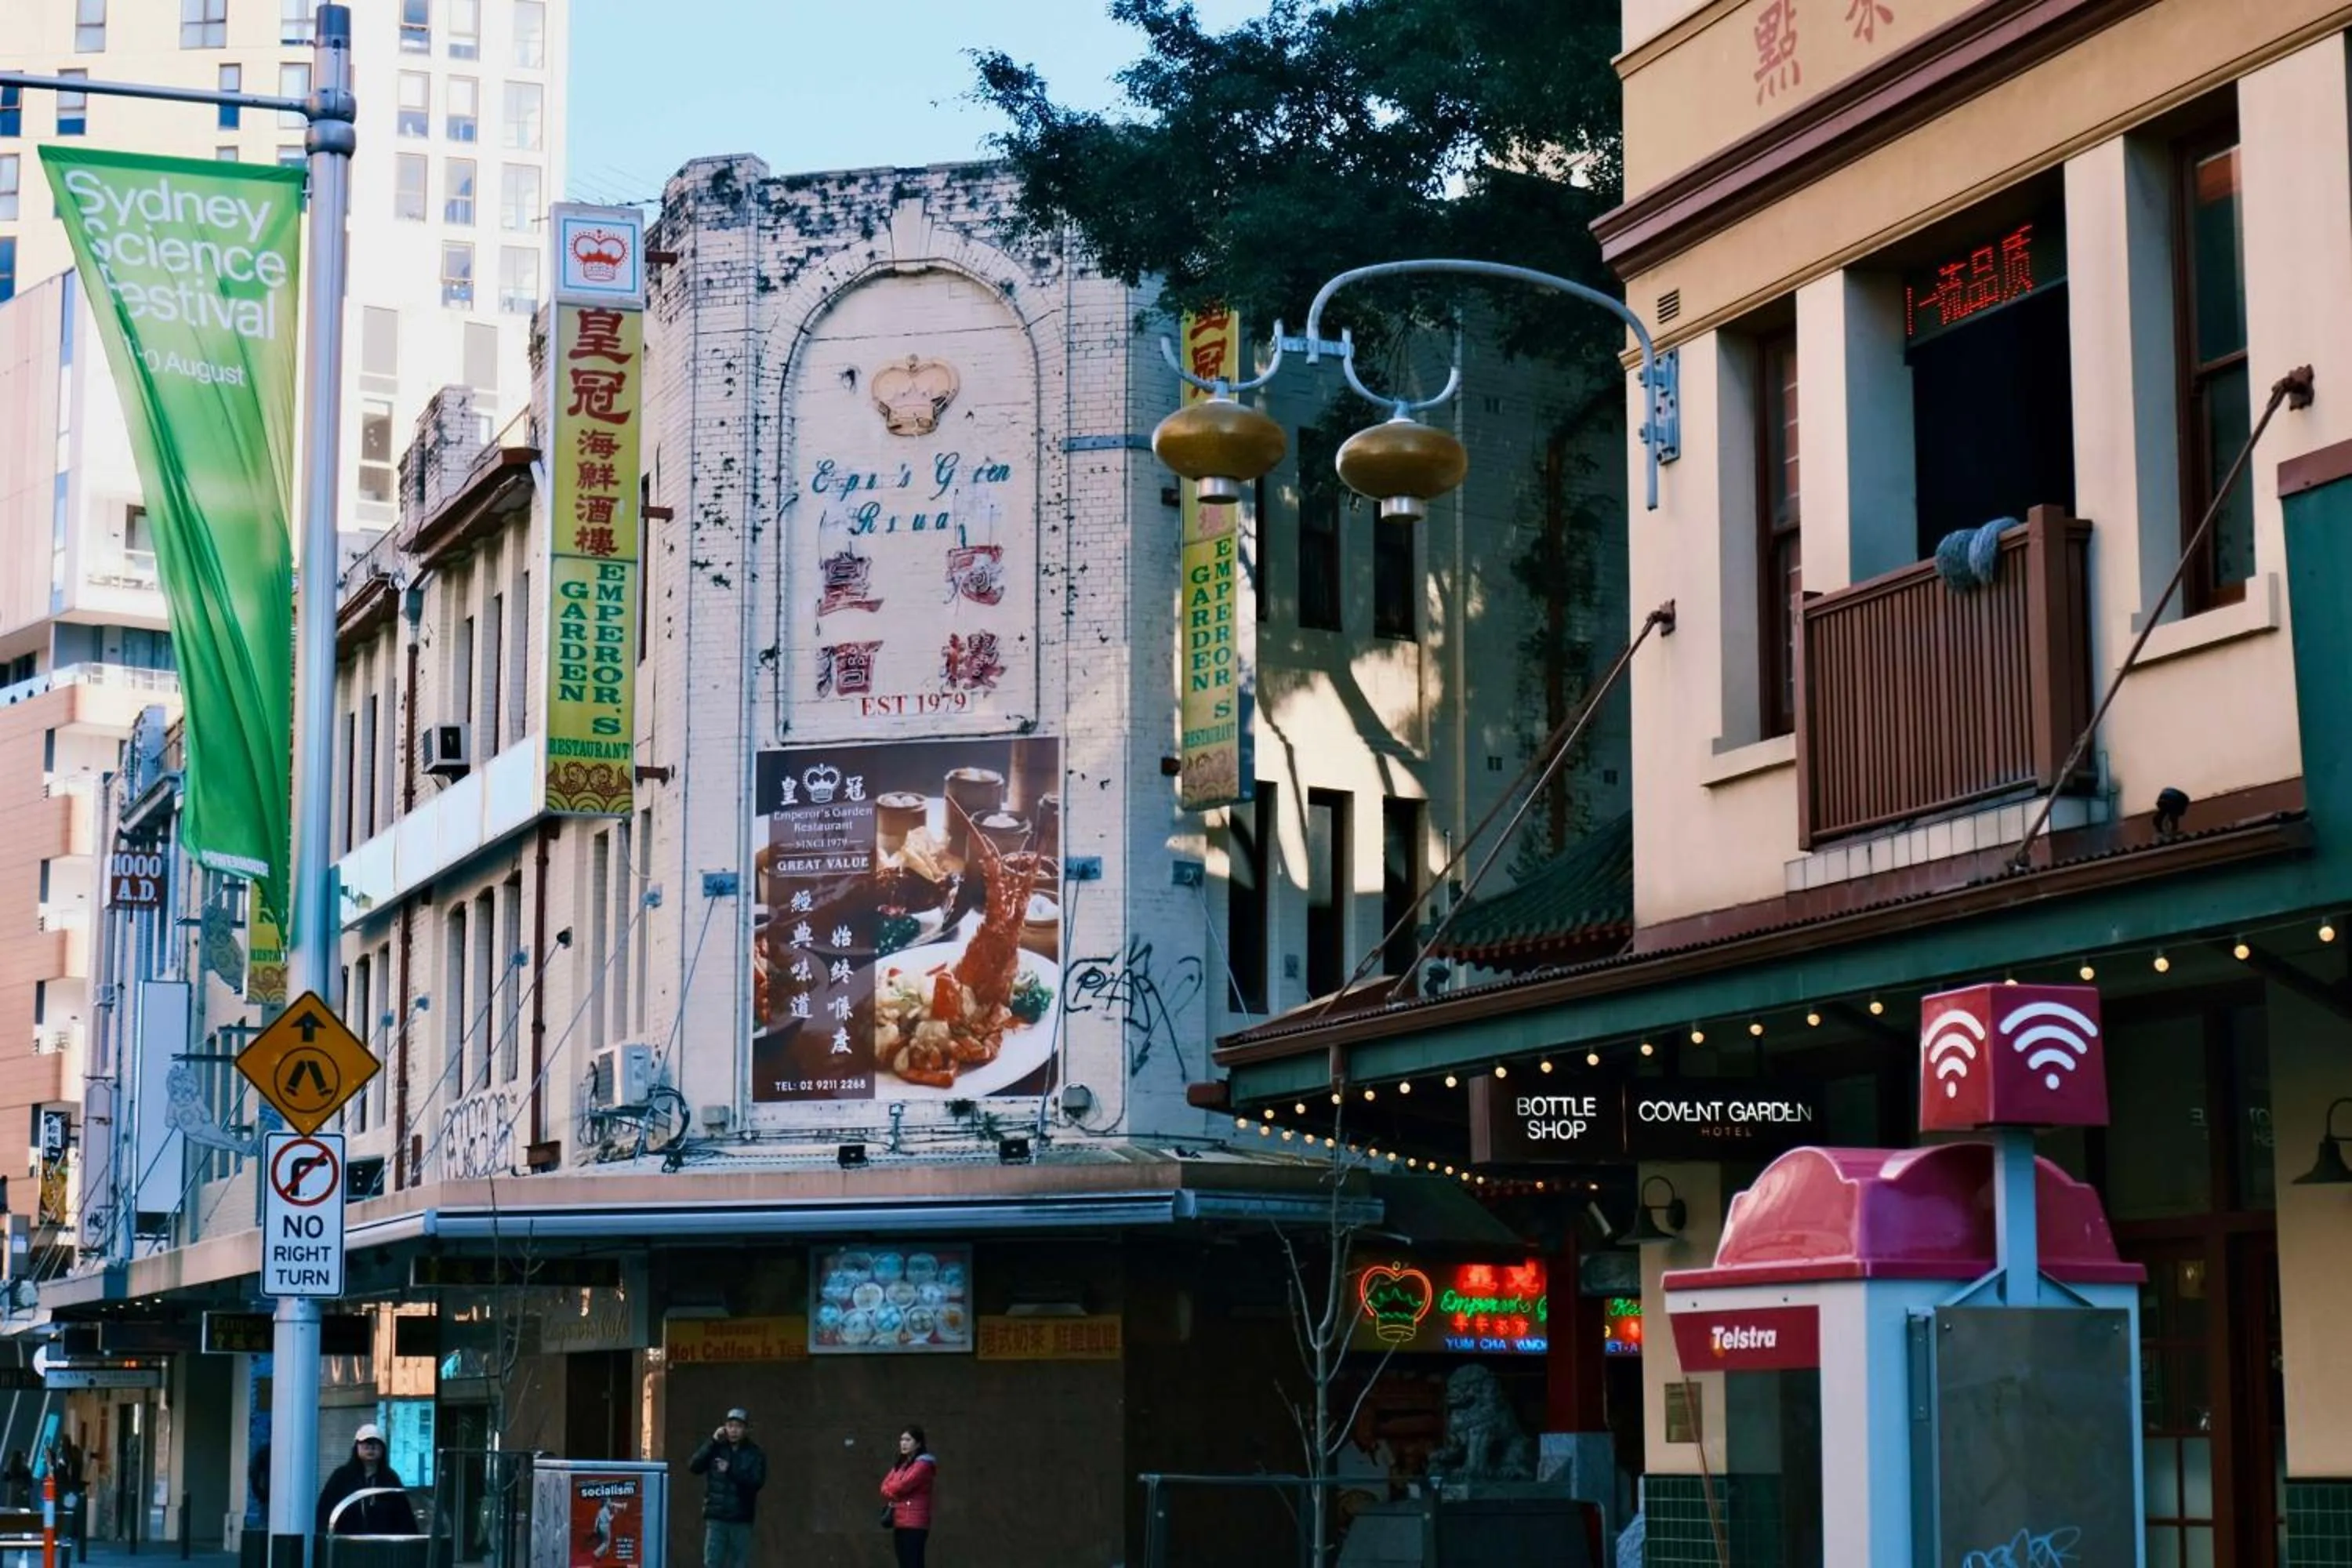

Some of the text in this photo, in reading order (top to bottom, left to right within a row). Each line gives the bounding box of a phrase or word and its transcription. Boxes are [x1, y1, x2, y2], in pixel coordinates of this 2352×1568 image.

[65, 169, 271, 241] Sydney
[84, 217, 286, 289] Science
[165, 350, 247, 387] August
[1190, 565, 1210, 692] GARDEN
[558, 582, 589, 702] GARDEN
[860, 691, 967, 717] EST 1979
[550, 737, 630, 760] RESTAURANT
[774, 807, 873, 822] Emperor's Garden
[794, 821, 852, 832] Restaurant
[113, 855, 162, 877] 1000
[777, 857, 869, 872] GREAT VALUE
[117, 881, 158, 902] A.D.
[800, 1080, 814, 1091] 02
[1516, 1096, 1597, 1117] BOTTLE
[1639, 1101, 1812, 1123] COVENT GARDEN
[1527, 1120, 1588, 1141] SHOP
[1701, 1126, 1752, 1138] HOTEL
[283, 1215, 324, 1239] NO
[274, 1246, 332, 1262] RIGHT
[276, 1269, 329, 1286] TURN
[1445, 1338, 1474, 1352] YUM
[1479, 1338, 1507, 1352] CHA
[1711, 1326, 1777, 1350] Telstra
[702, 1341, 754, 1359] Coffee
[581, 1483, 634, 1497] socialism
